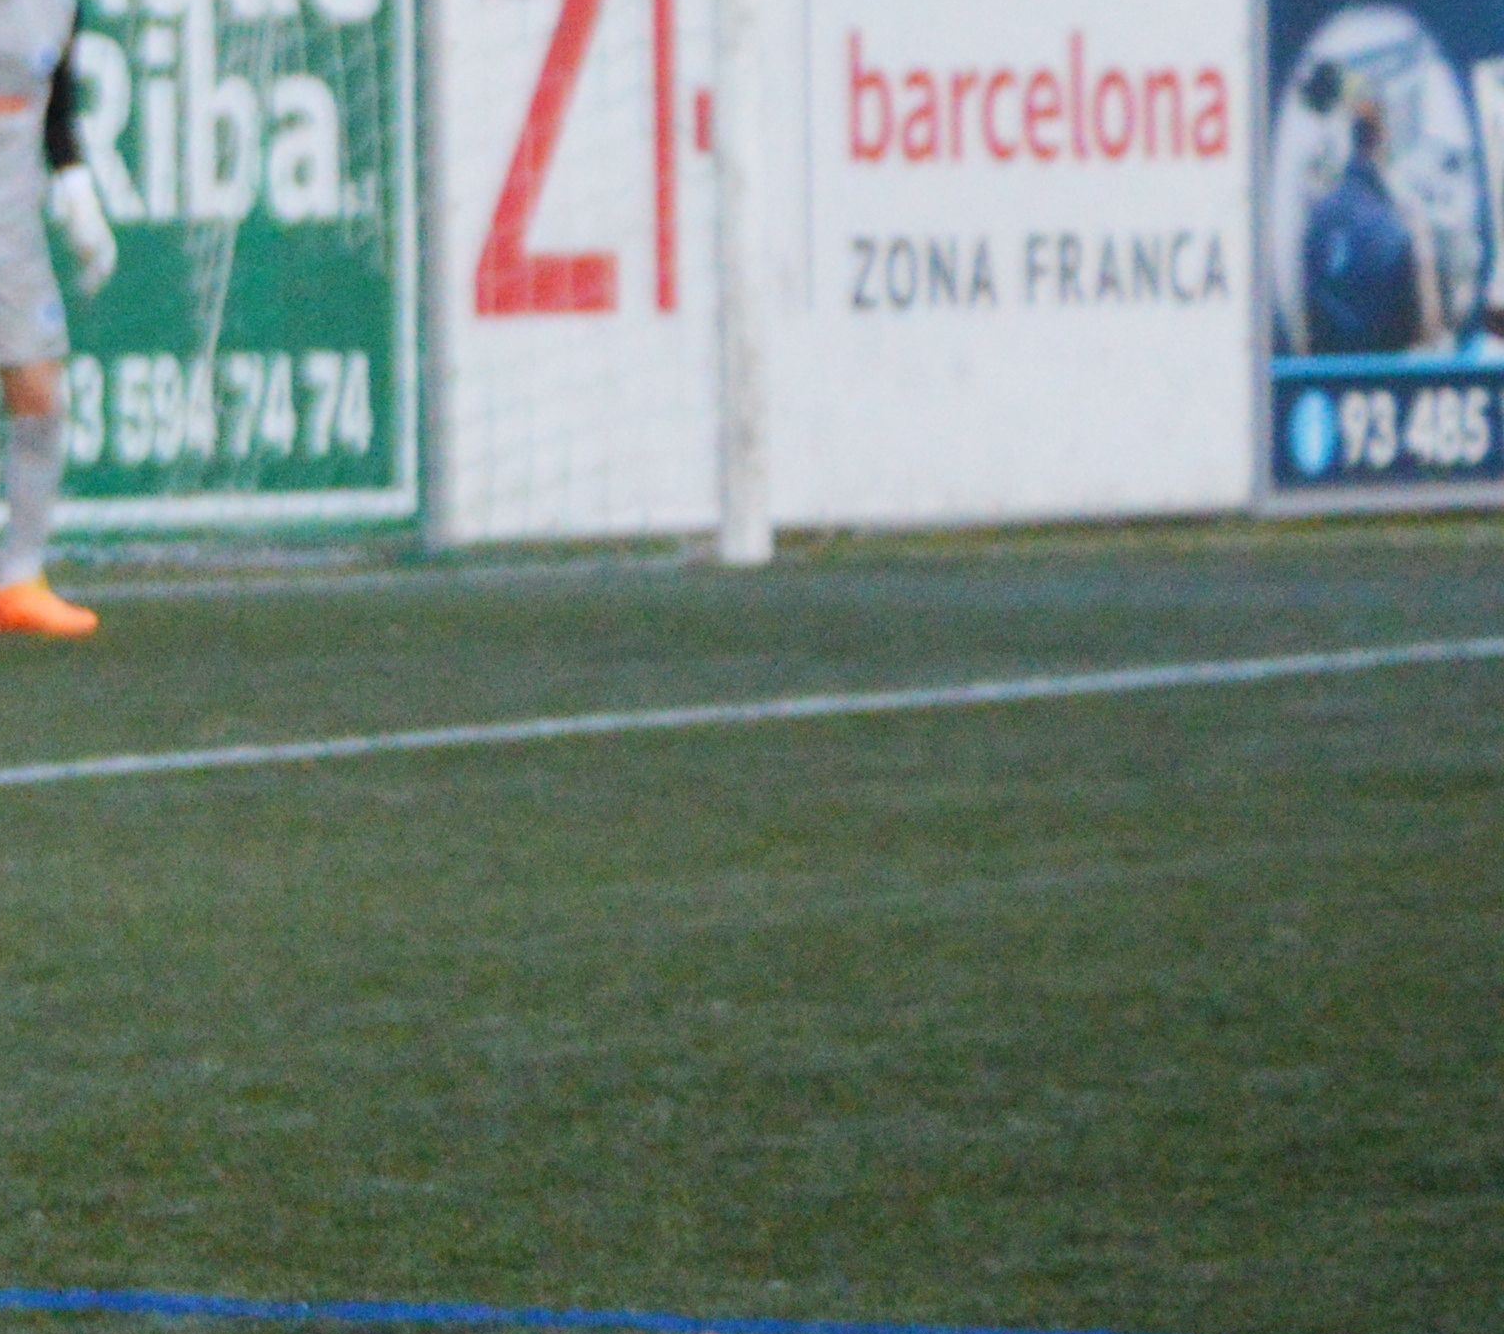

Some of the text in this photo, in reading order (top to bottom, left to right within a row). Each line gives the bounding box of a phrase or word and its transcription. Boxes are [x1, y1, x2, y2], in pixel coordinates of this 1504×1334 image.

[70, 25, 339, 223] Riba
[848, 28, 1229, 162] barcelona
[851, 229, 1229, 312] ZONA FRANCA
[230, 350, 296, 459] 74
[303, 348, 374, 457] 74
[1339, 389, 1397, 468] 93
